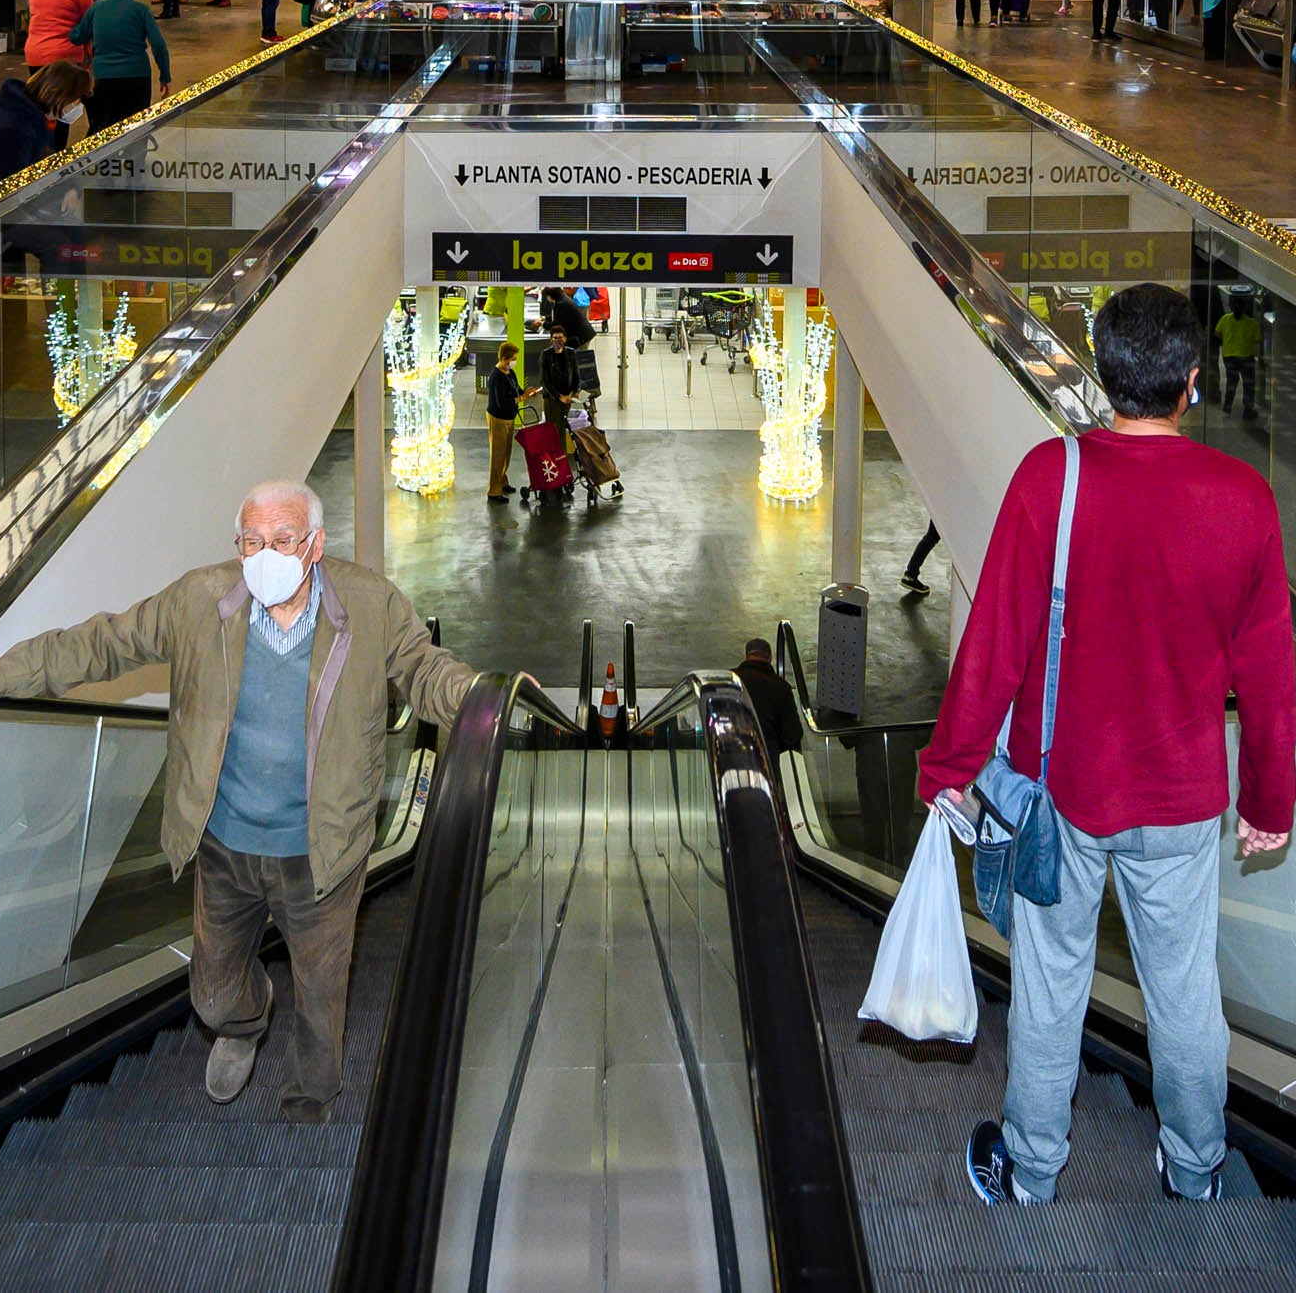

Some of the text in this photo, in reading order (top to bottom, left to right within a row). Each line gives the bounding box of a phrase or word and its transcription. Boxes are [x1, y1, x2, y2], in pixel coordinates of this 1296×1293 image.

[473, 166, 542, 184] PLANTA
[548, 166, 621, 185] SOTANO
[638, 167, 752, 186] PESCADERIA
[512, 240, 542, 270] la
[558, 240, 653, 278] plaza
